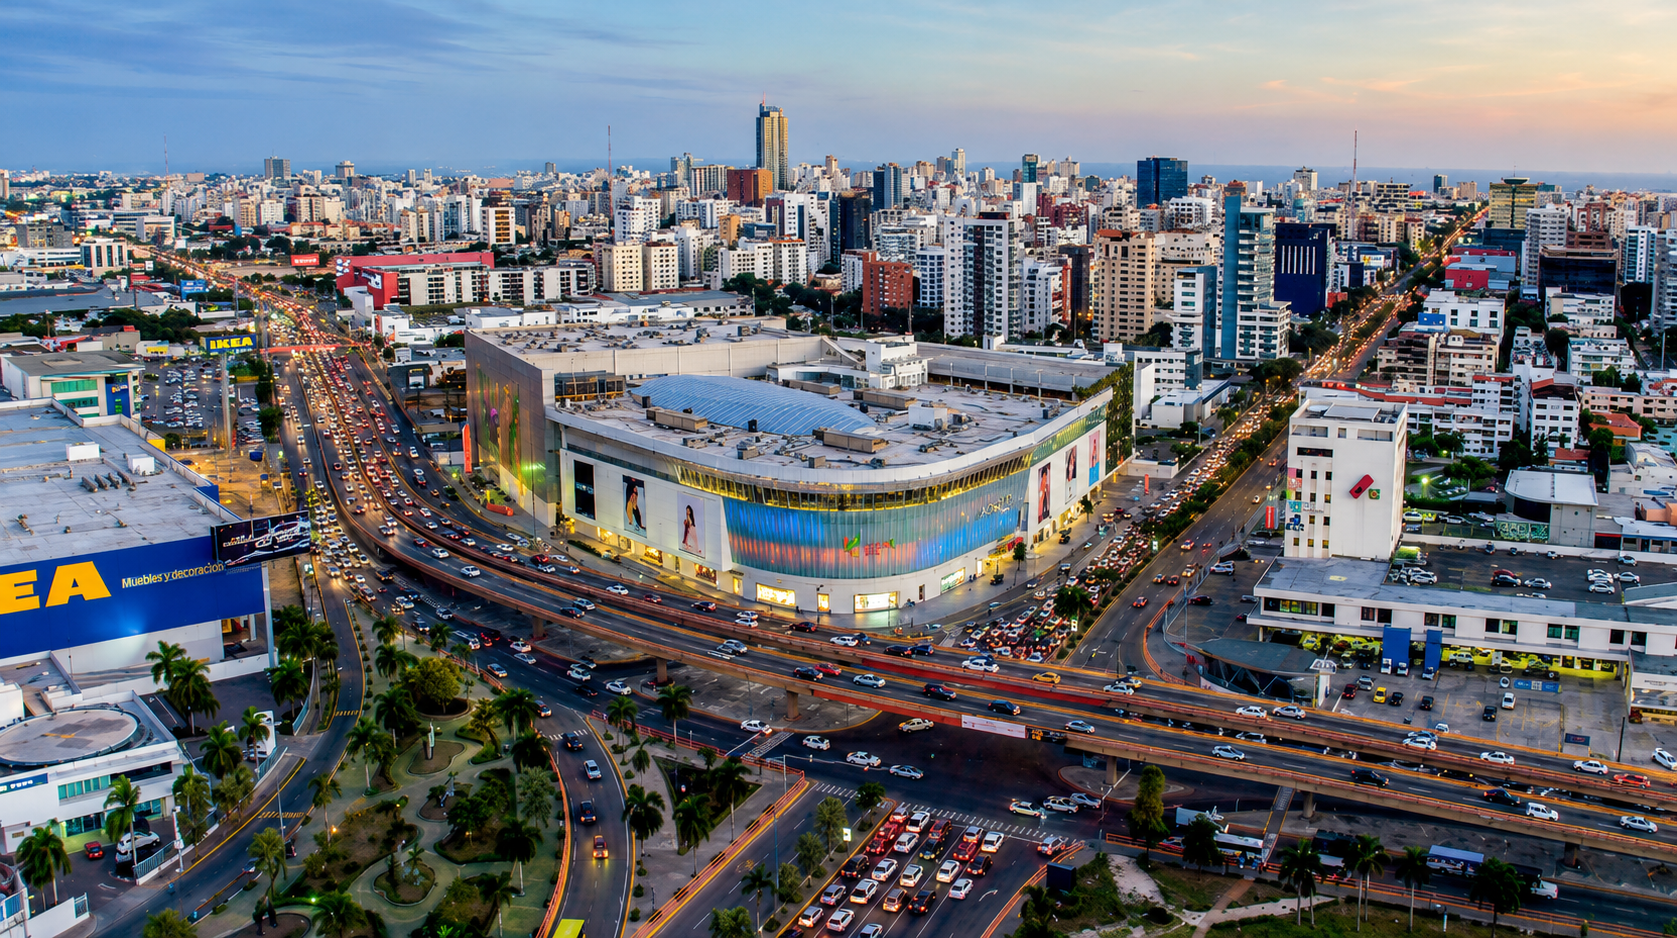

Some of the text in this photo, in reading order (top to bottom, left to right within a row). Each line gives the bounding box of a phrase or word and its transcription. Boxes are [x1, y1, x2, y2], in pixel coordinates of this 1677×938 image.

[210, 337, 253, 349] IKEA
[0, 561, 112, 615] EA
[121, 573, 163, 589] Muebles
[164, 571, 171, 583] y
